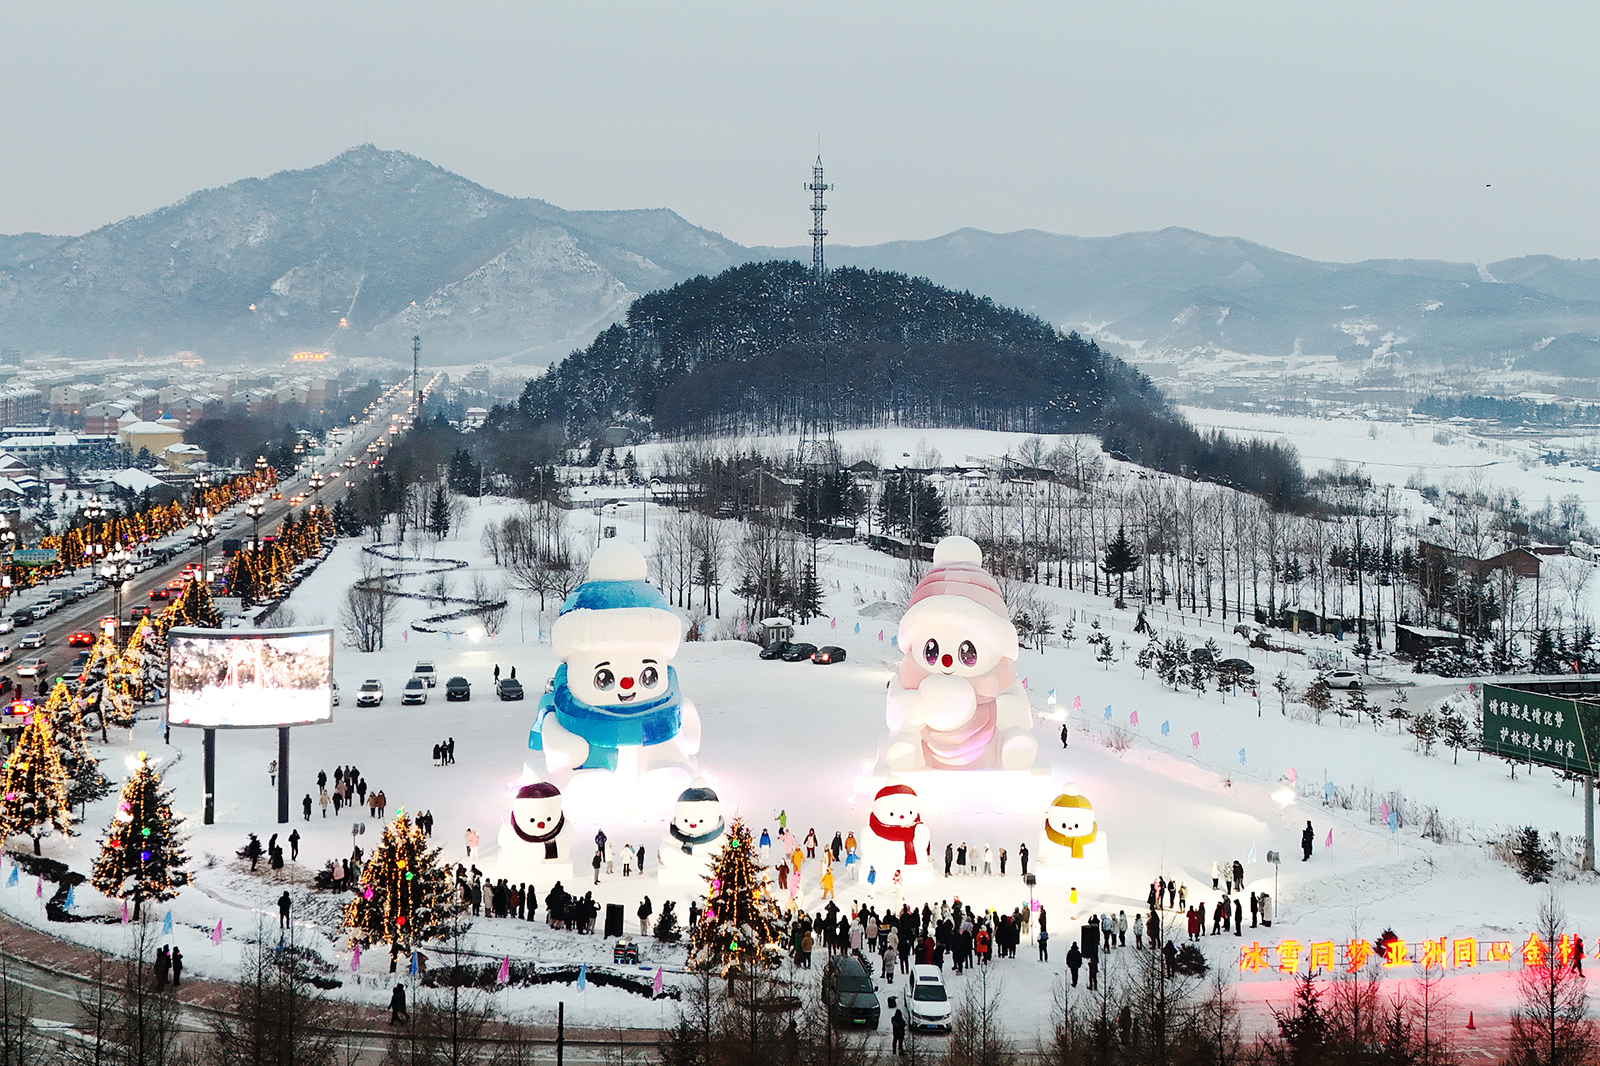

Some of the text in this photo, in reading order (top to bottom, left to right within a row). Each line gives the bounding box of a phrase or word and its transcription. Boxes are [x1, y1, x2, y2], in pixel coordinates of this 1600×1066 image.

[1489, 699, 1564, 728] 增绿就是增优势
[1500, 727, 1575, 758] 护林就是护财富
